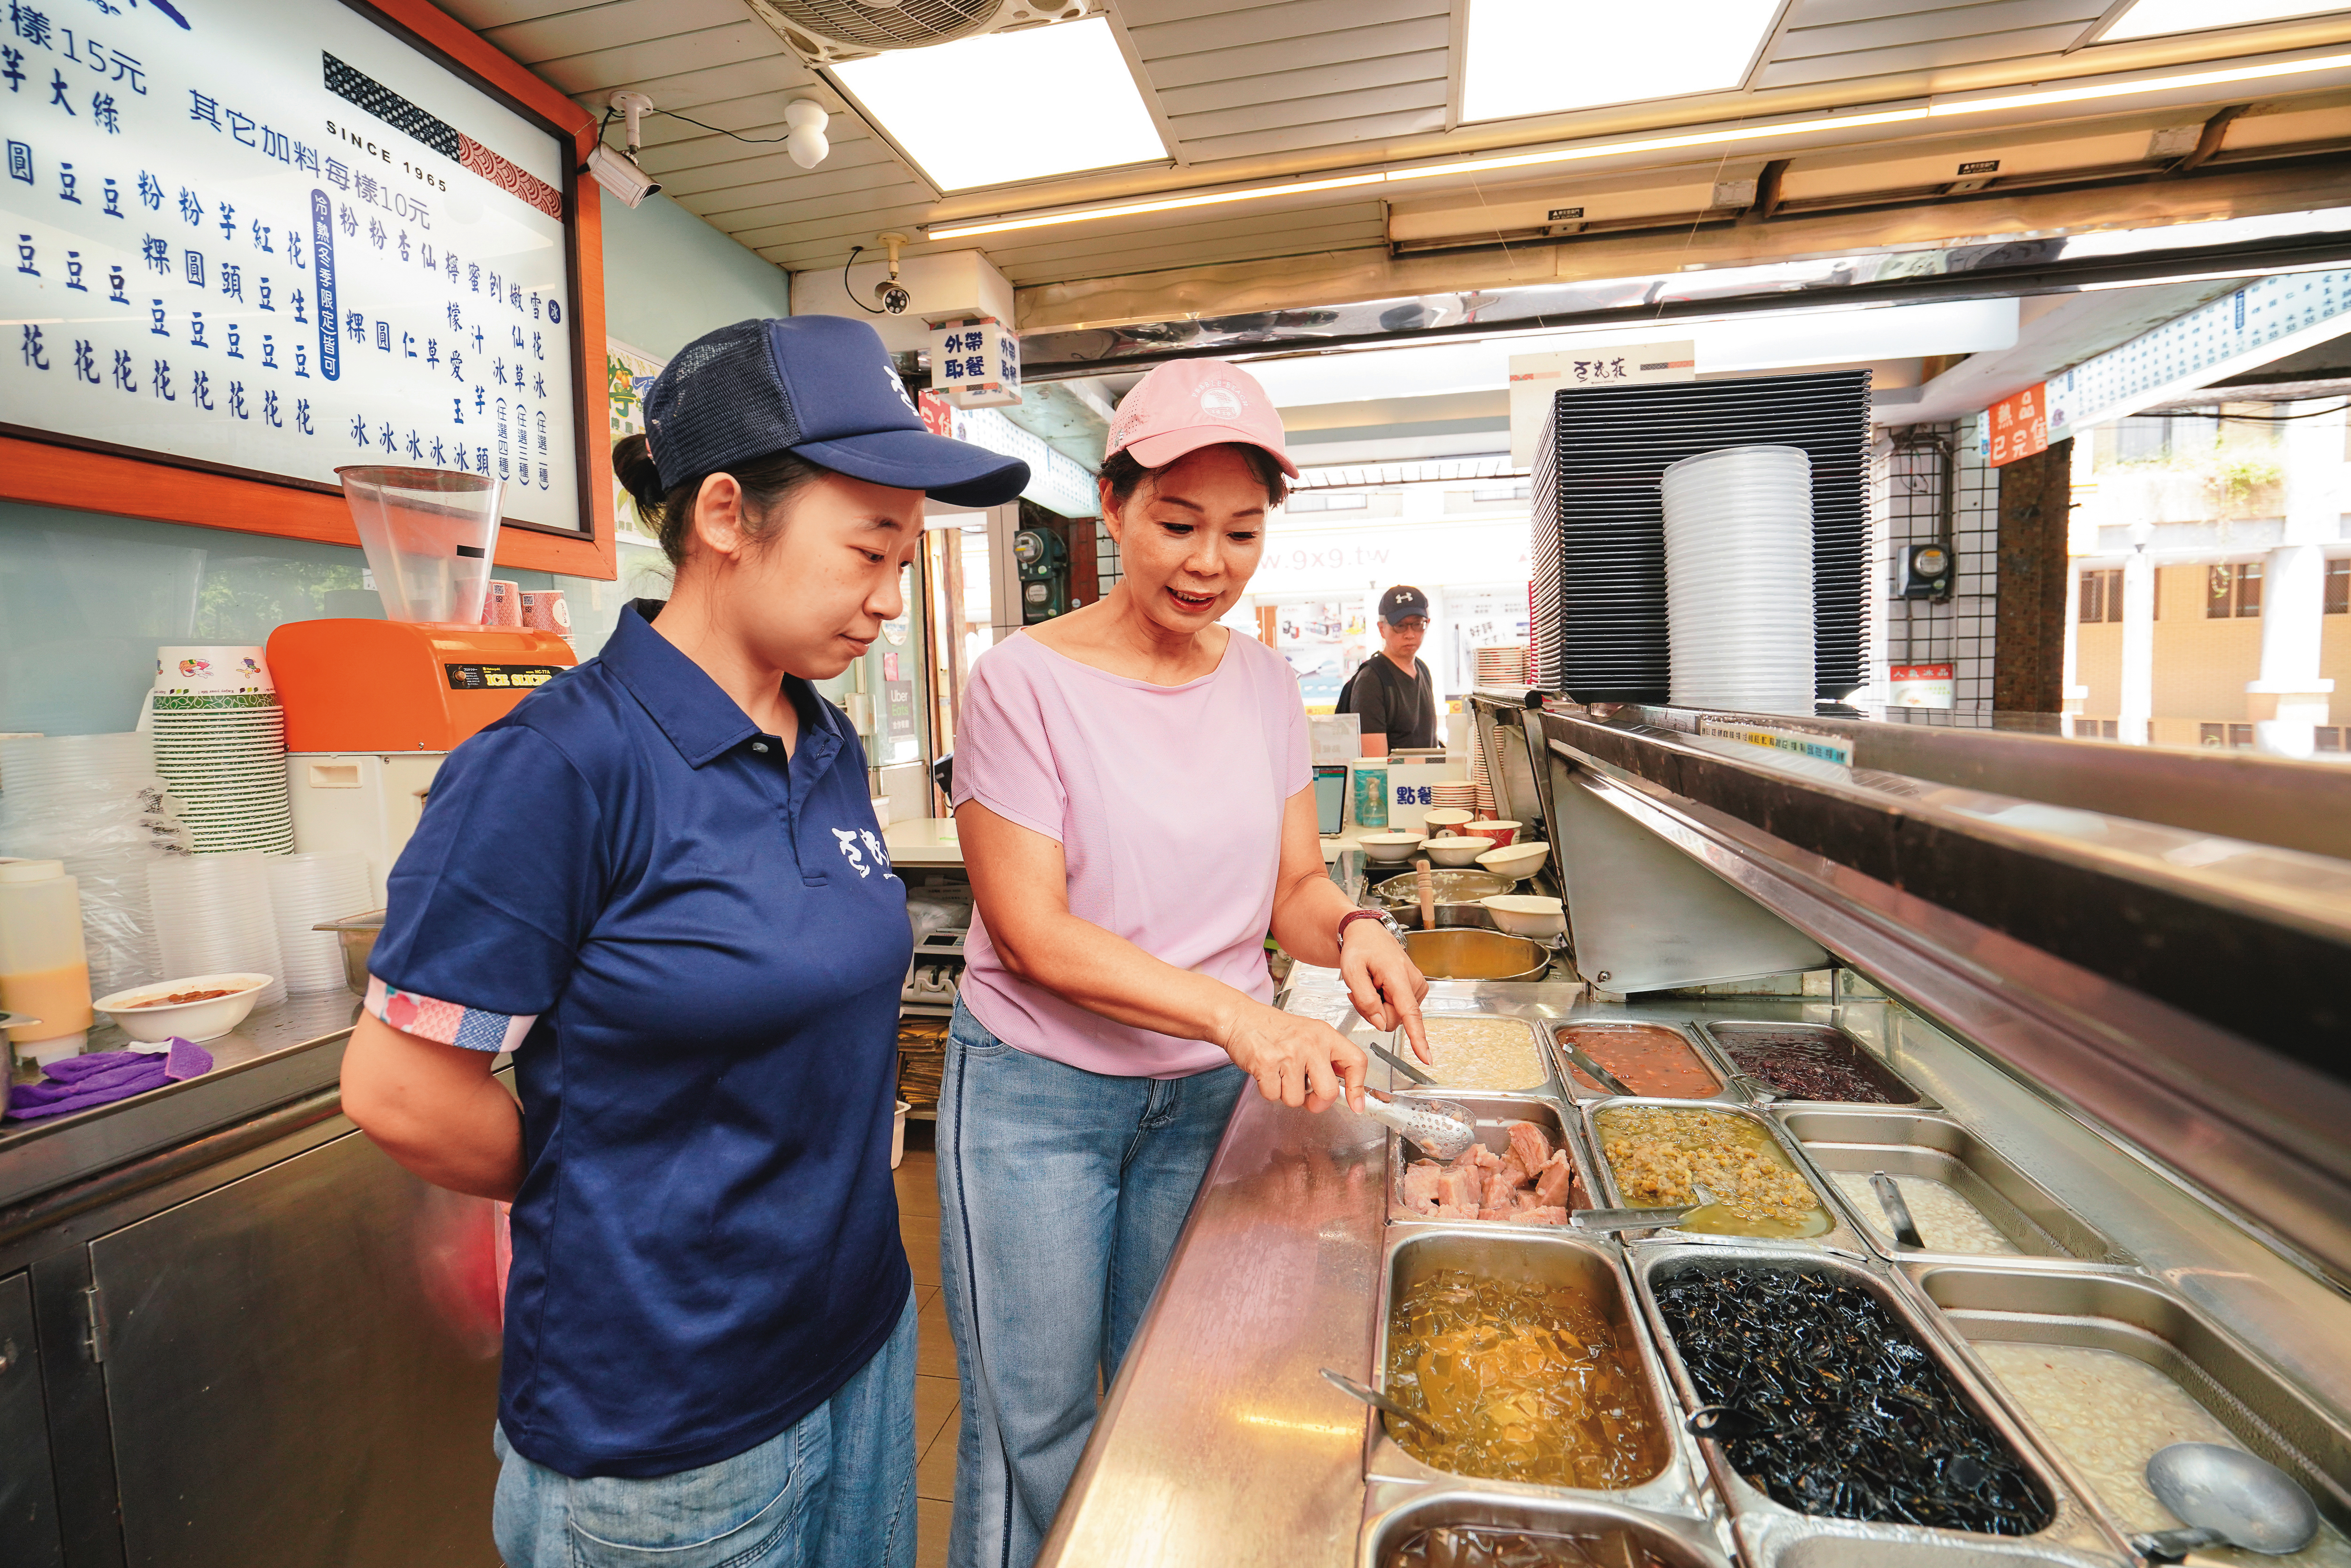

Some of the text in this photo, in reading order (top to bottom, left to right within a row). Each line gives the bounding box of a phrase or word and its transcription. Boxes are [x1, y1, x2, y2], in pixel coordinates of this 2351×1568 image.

[0, 0, 147, 95] 樣15元
[1, 44, 49, 370] 芋圓豆花
[50, 68, 100, 384] 大豆豆花
[189, 89, 430, 230] 其它加料每樣10元
[326, 120, 447, 192] SINCE 1965
[92, 90, 137, 393] 綠豆豆花
[137, 169, 175, 401] 粉粿豆花
[179, 186, 214, 410] 粉圓豆花
[219, 201, 249, 420] 芋頭豆花
[549, 303, 559, 320] 冰
[252, 218, 282, 428] 紅豆豆花
[287, 230, 314, 435] 花生豆花
[339, 202, 370, 448] 粉粿冰
[369, 216, 397, 455] 粉圓冰
[397, 229, 424, 461] 杏仁冰
[421, 242, 446, 467] 仙草冰
[945, 331, 983, 354] 外帶
[945, 355, 985, 379] 取餐
[1001, 337, 1016, 362] 外帶
[1191, 380, 1248, 406] PEBBLE BEACH
[485, 674, 510, 686] ICE
[891, 689, 908, 702] Uber
[891, 704, 909, 717] Eats
[1893, 668, 1949, 678] 人氣冰品
[1396, 786, 1431, 805] 點餐
